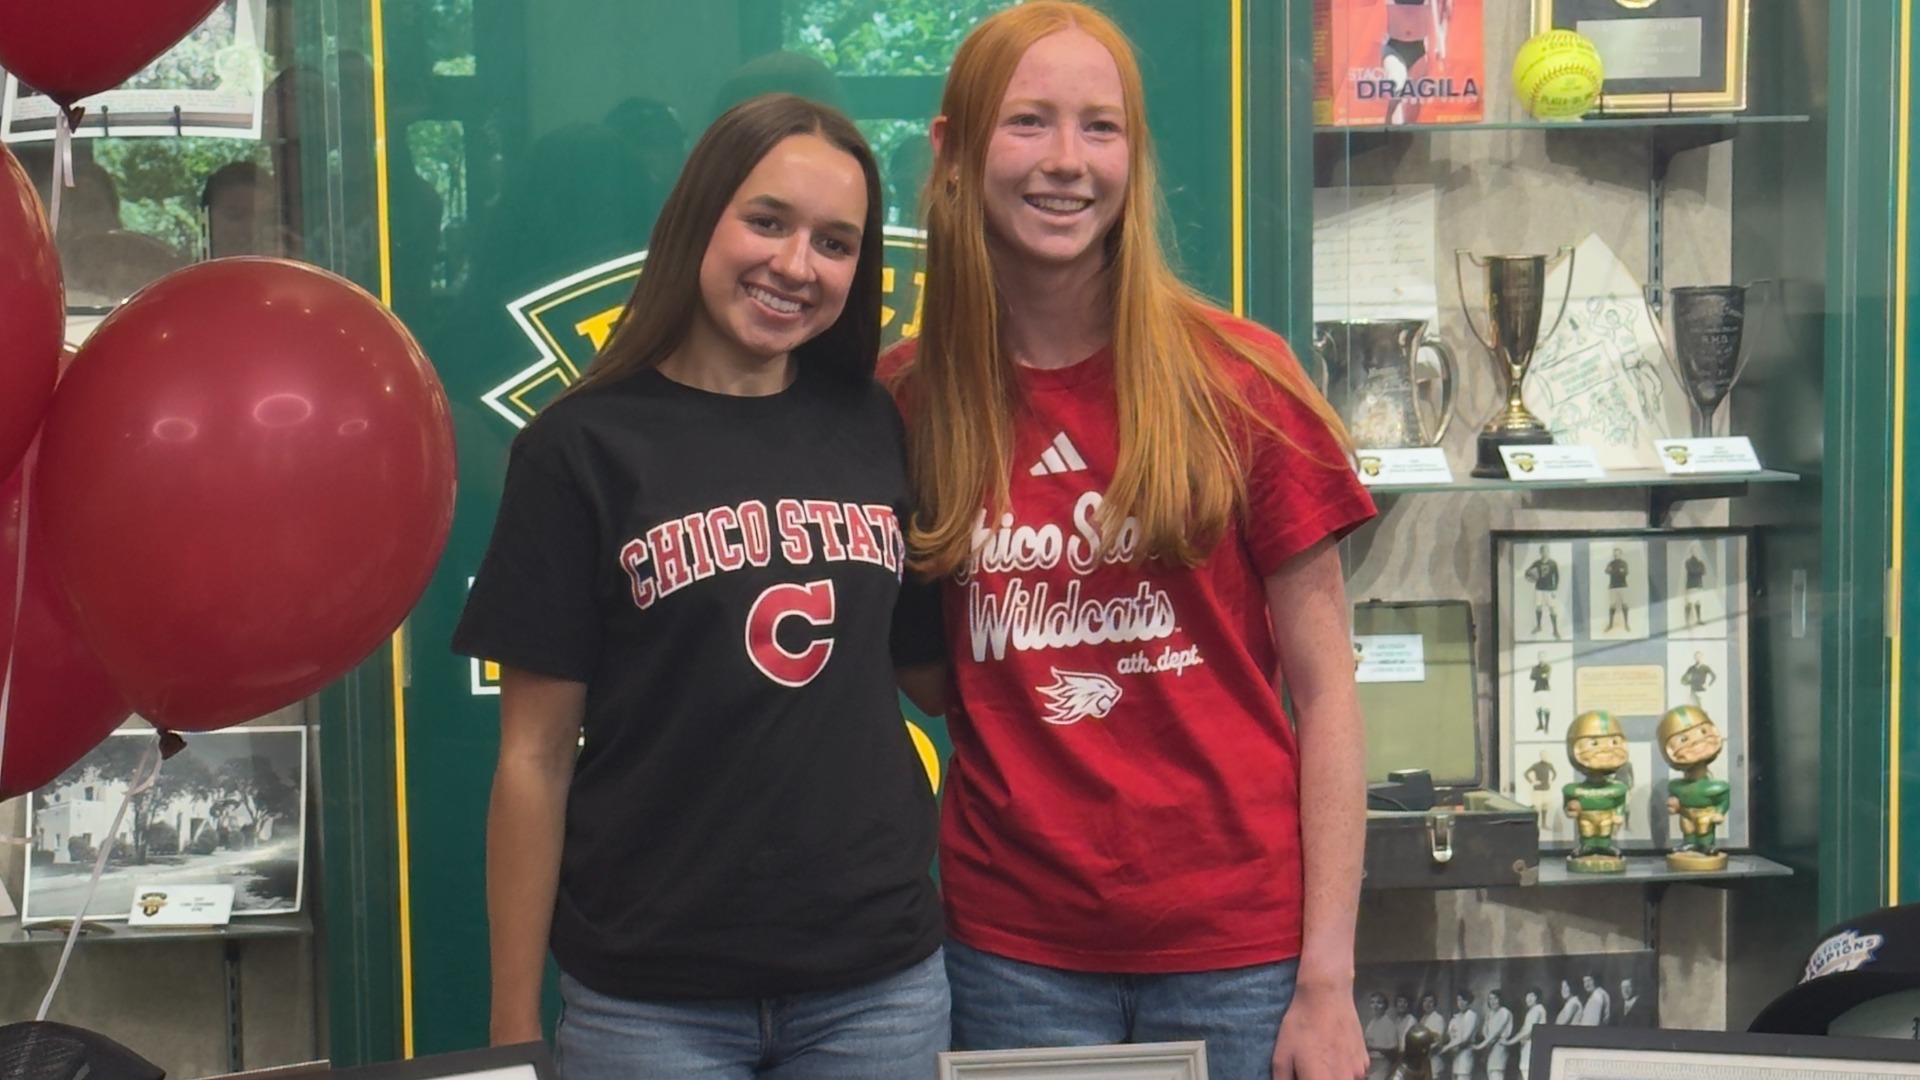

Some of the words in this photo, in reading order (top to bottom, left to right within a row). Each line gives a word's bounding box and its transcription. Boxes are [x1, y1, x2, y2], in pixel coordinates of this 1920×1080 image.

[1357, 78, 1478, 99] DRAGILA
[620, 500, 771, 610] CHICO
[775, 499, 905, 583] STAT
[954, 508, 1063, 586] hico
[745, 579, 836, 688] C
[969, 577, 1176, 663] Wildcats
[1809, 938, 1875, 979] AMPIONS
